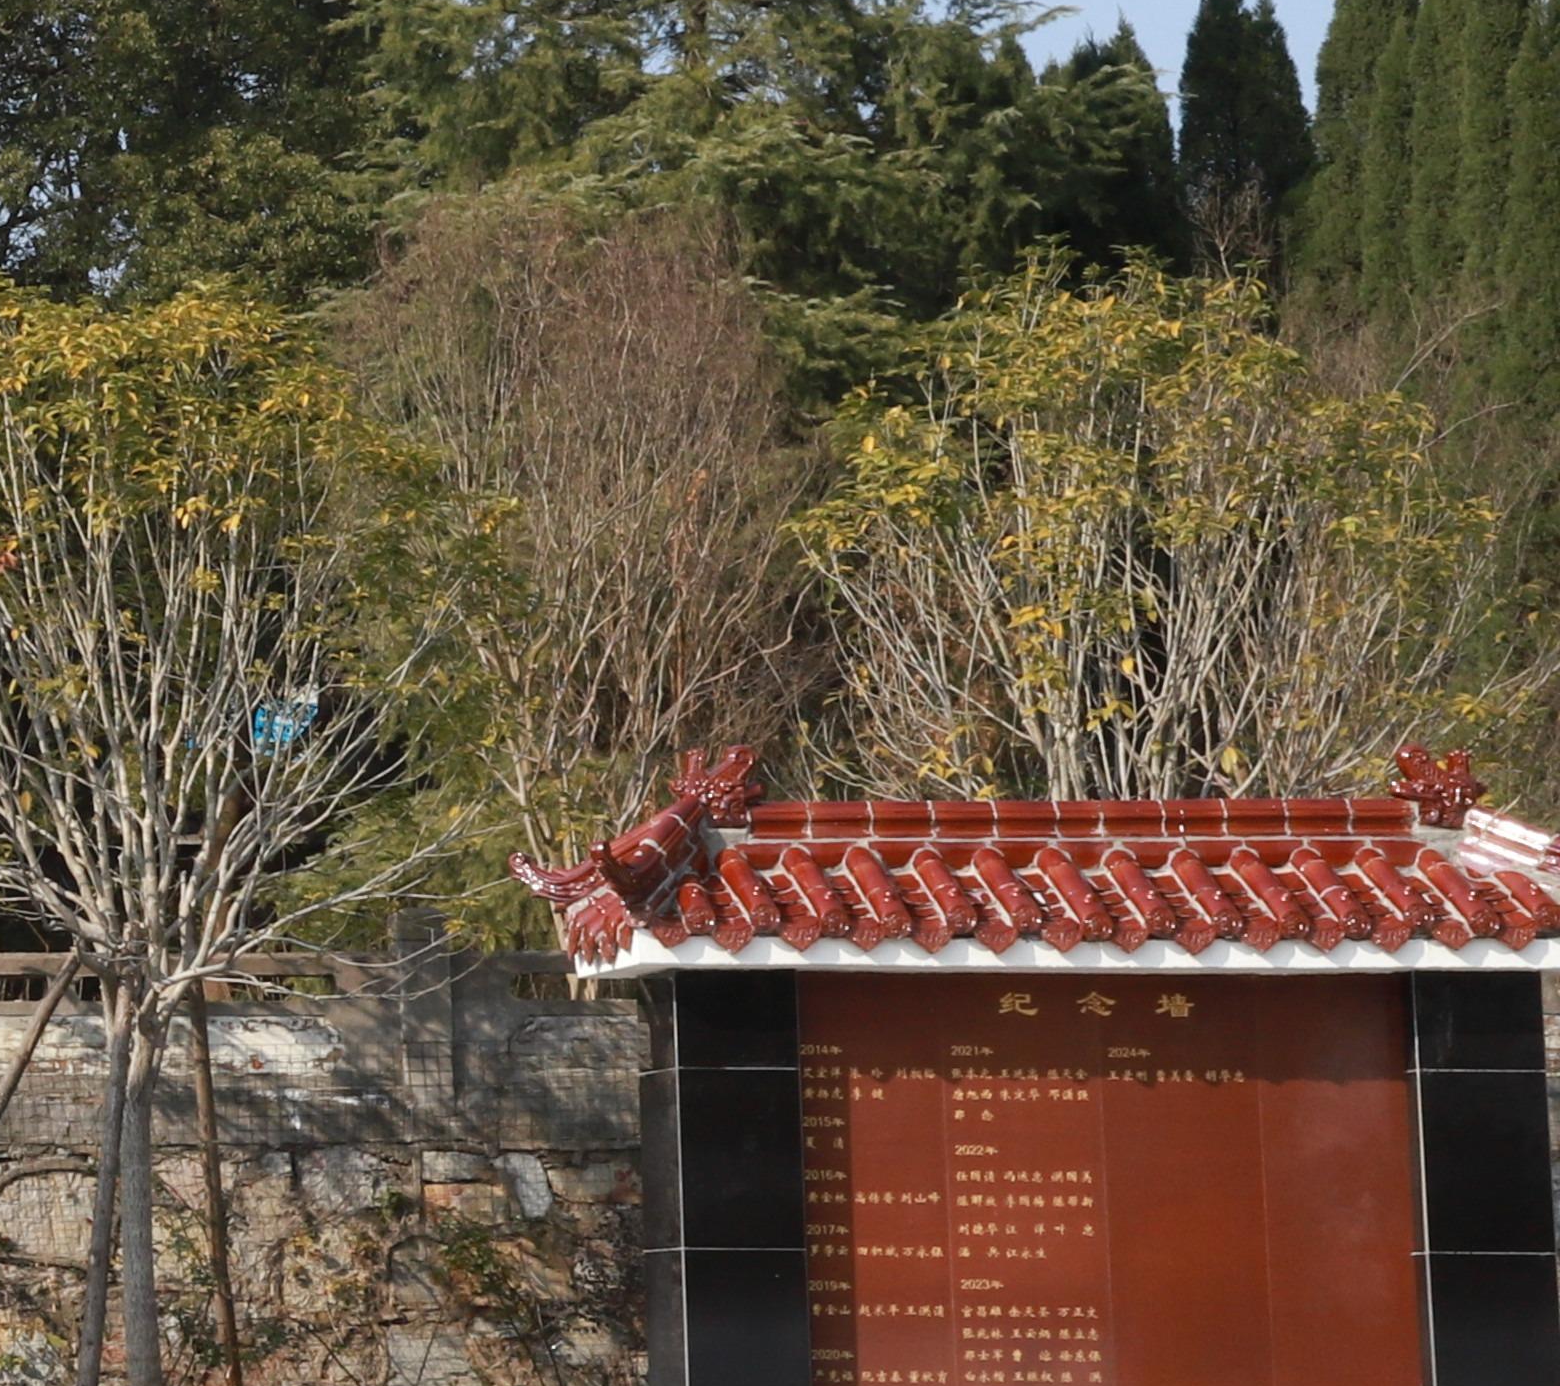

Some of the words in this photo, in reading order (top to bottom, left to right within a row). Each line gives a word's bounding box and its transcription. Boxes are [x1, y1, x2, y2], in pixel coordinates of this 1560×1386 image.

[998, 991, 1195, 1018] 纪念墙
[800, 1044, 843, 1055] 2014年
[950, 1045, 994, 1056] 2021年
[1107, 1047, 1151, 1059] 2024年
[802, 1116, 845, 1127] 2015年
[954, 1144, 998, 1156] 2022年
[804, 1169, 847, 1181] 2016年
[807, 1224, 849, 1235] 2017年
[808, 1280, 851, 1291] 2019年
[960, 1279, 1004, 1290] 2023年
[811, 1349, 854, 1360] 2020年
